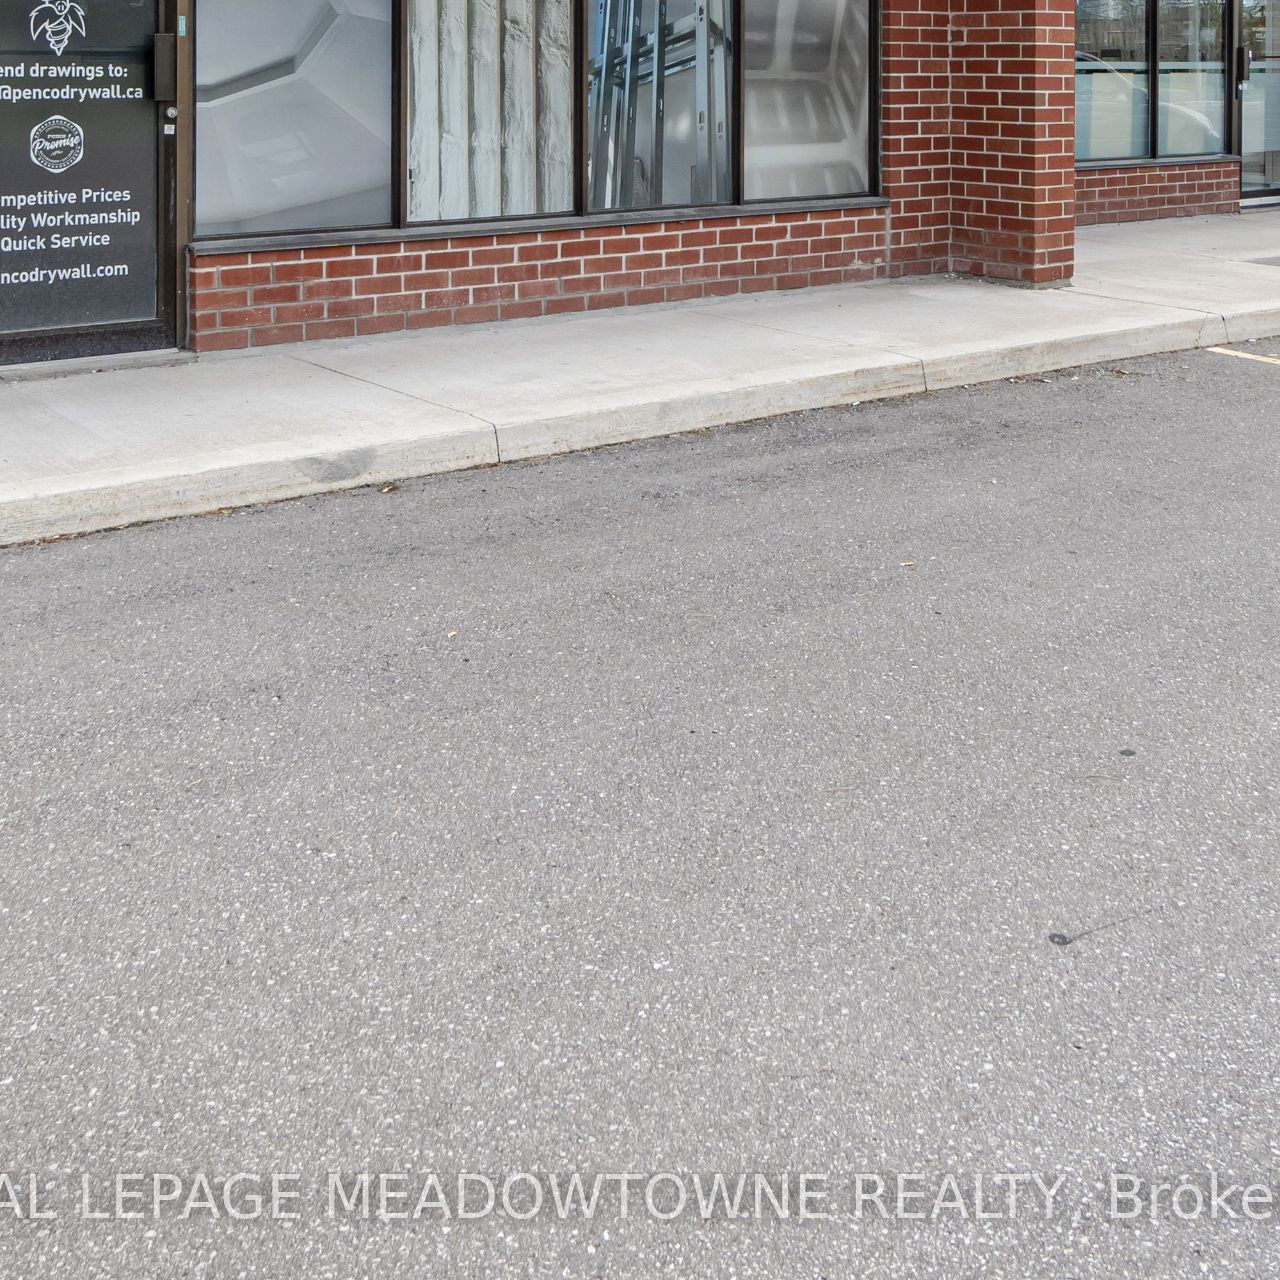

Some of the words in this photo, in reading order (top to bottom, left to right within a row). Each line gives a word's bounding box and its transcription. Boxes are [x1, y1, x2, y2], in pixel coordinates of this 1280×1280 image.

[29, 62, 104, 81] drawings
[107, 63, 128, 78] to:
[32, 135, 80, 156] Promise
[81, 189, 131, 205] Prices
[31, 208, 141, 228] Workmanship
[0, 235, 47, 252] Quick
[50, 233, 111, 249] Service
